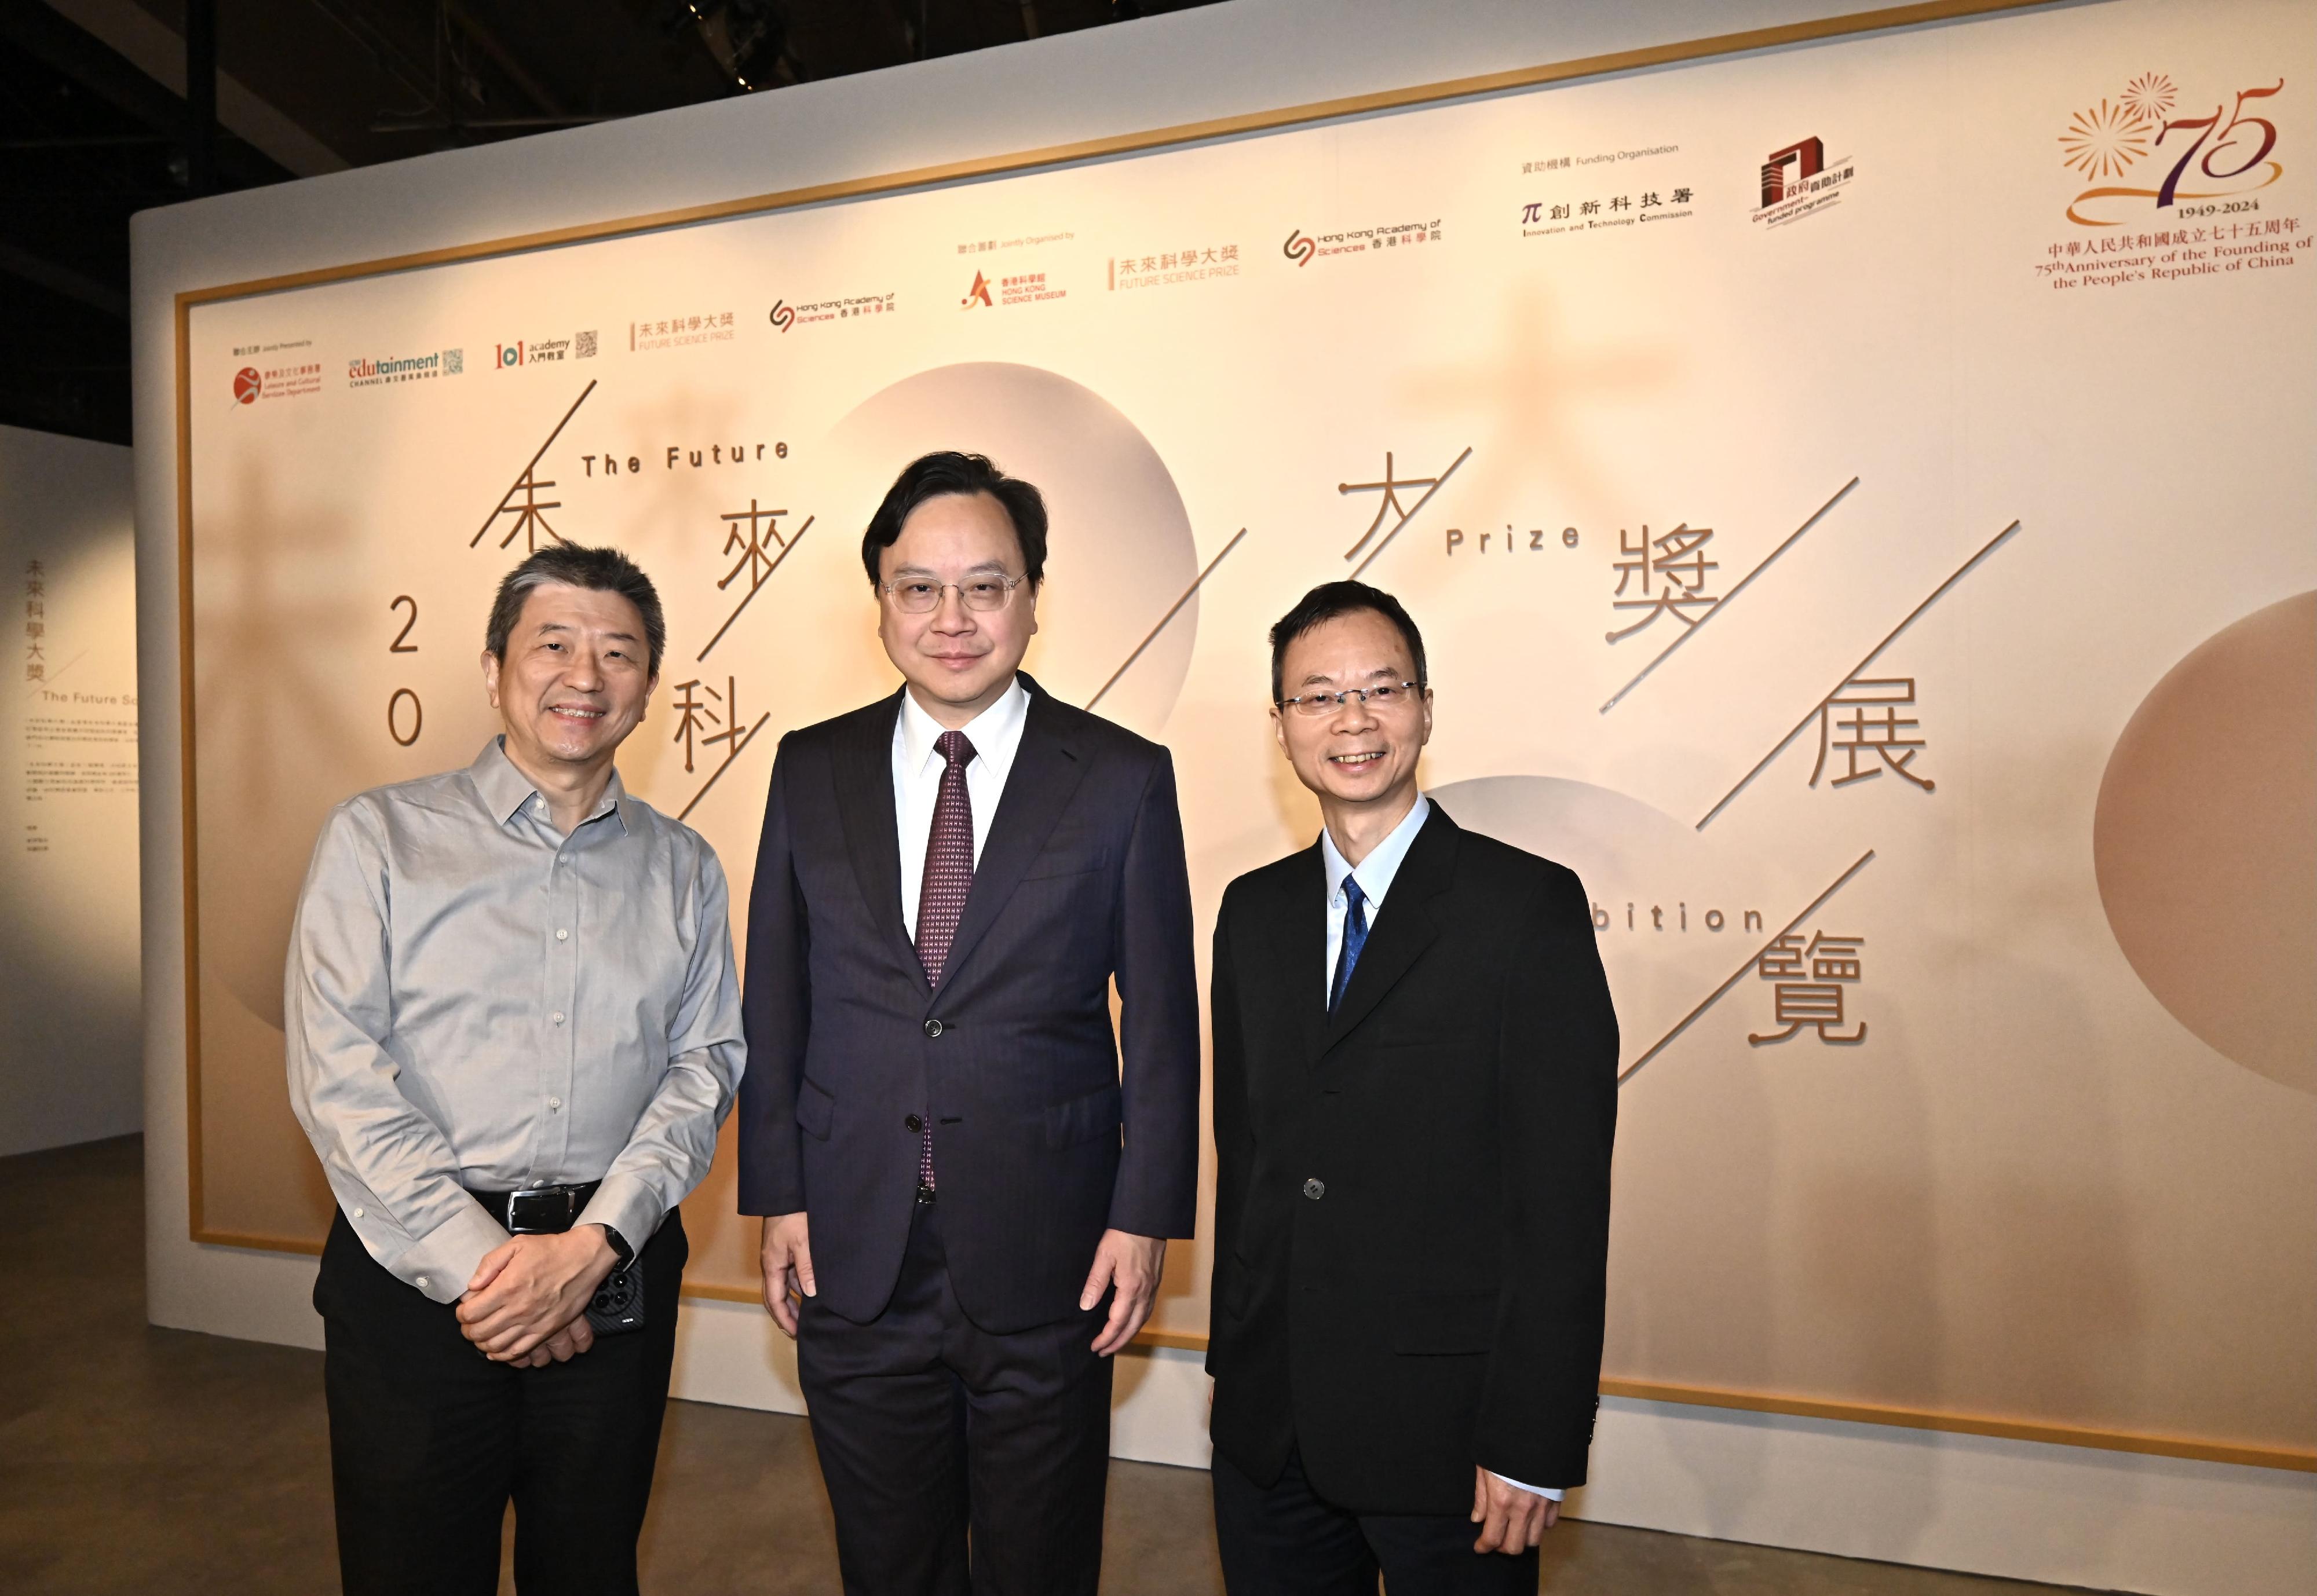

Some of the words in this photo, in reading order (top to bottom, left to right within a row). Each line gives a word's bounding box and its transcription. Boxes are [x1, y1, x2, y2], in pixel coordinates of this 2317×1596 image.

[2155, 78, 2284, 208] 75
[1522, 156, 1571, 174] 資助機構
[1576, 153, 1615, 167] Funding
[1617, 144, 1679, 160] Organisation
[1786, 166, 1854, 198] 政府資助計劃
[1550, 188, 1694, 220] 創新科技署
[1768, 210, 1793, 225] funded
[1795, 192, 1840, 215] programme
[2177, 199, 2258, 219] 1949-2024
[1318, 233, 1344, 243] Hong
[1347, 229, 1373, 239] Kong
[1377, 222, 1427, 235] Academy
[1430, 219, 1441, 228] of
[1523, 225, 1565, 237] Innovation
[1569, 223, 1584, 231] and
[1588, 216, 1635, 229] Technology
[1639, 209, 1693, 222] Commission
[1001, 239, 1024, 248] Jointly
[1026, 232, 1064, 246] Organised
[1065, 232, 1075, 241] by
[1318, 244, 1366, 256] Sciences
[1372, 230, 1442, 250] 香港科學院
[2048, 217, 2301, 257] 中華人民共和國成立七十五周年
[2161, 250, 2178, 263] of
[2183, 247, 2206, 261] the
[2214, 241, 2289, 258] Founding
[2296, 236, 2314, 250] of
[1119, 244, 1239, 275] 未來科學大獎
[2054, 276, 2077, 289] the
[2083, 270, 2145, 286] People's
[2152, 262, 2219, 280] Republic
[2225, 259, 2242, 271] of
[2248, 255, 2294, 269] China
[1002, 273, 1046, 287] 香港科學館
[1002, 286, 1023, 296] HONG
[1025, 284, 1046, 293] KONG
[1119, 274, 1161, 290] FUTURE
[1163, 269, 1206, 285] SCIENCE
[1208, 264, 1240, 279] PRIZE
[820, 300, 842, 309] Kong
[844, 296, 883, 306] Academy
[886, 292, 894, 301] of
[1002, 294, 1032, 305] SCIENCE
[1035, 290, 1066, 301] MUSEUM
[639, 312, 734, 338] 未來科學大獎
[797, 313, 835, 324] Sciences
[529, 339, 570, 352] academy
[639, 338, 671, 350] FUTURE
[674, 334, 707, 346] SCIENCE
[710, 330, 734, 342] PRIZE
[349, 353, 438, 378] edutainment
[350, 378, 383, 388] CHANNEL
[582, 455, 641, 477] The
[667, 442, 789, 469] Future
[1446, 524, 1581, 555] Prize
[25, 560, 45, 682] 未來科學大獎
[42, 690, 68, 702] The
[74, 692, 117, 704] Future
[673, 676, 746, 773] 科
[1808, 678, 1936, 792] 展
[1748, 929, 1866, 1046] 覽
